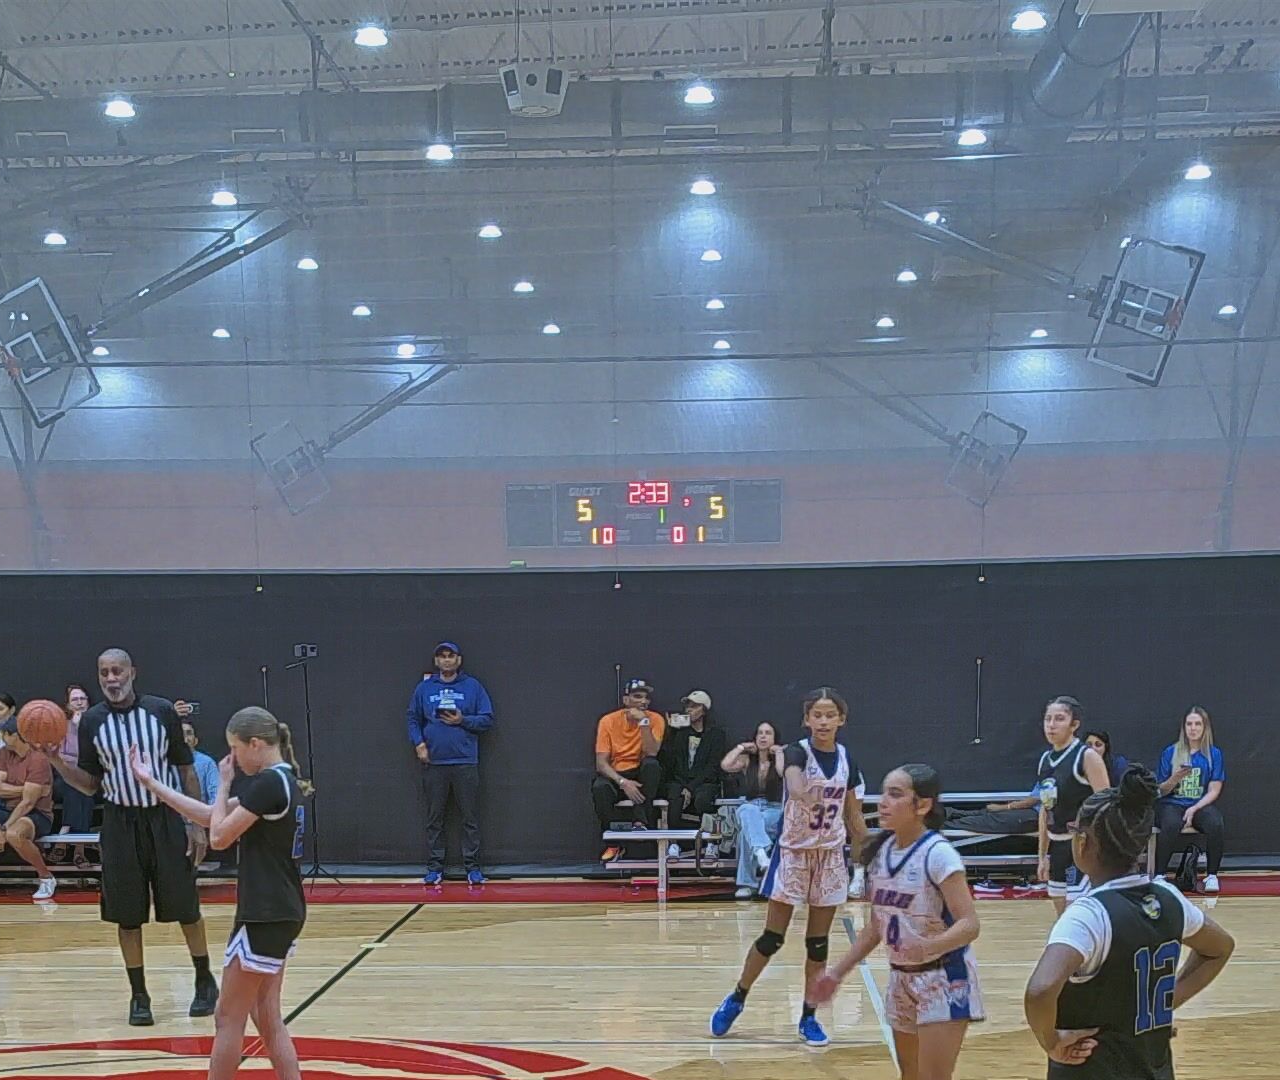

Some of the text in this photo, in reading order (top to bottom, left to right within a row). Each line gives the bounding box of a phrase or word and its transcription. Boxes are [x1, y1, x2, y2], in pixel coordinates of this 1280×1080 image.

[628, 482, 669, 504] 2:33
[577, 499, 592, 521] 5
[709, 496, 723, 519] 5
[602, 527, 614, 545] 0
[673, 526, 684, 543] 0
[1134, 939, 1182, 1036] 12
